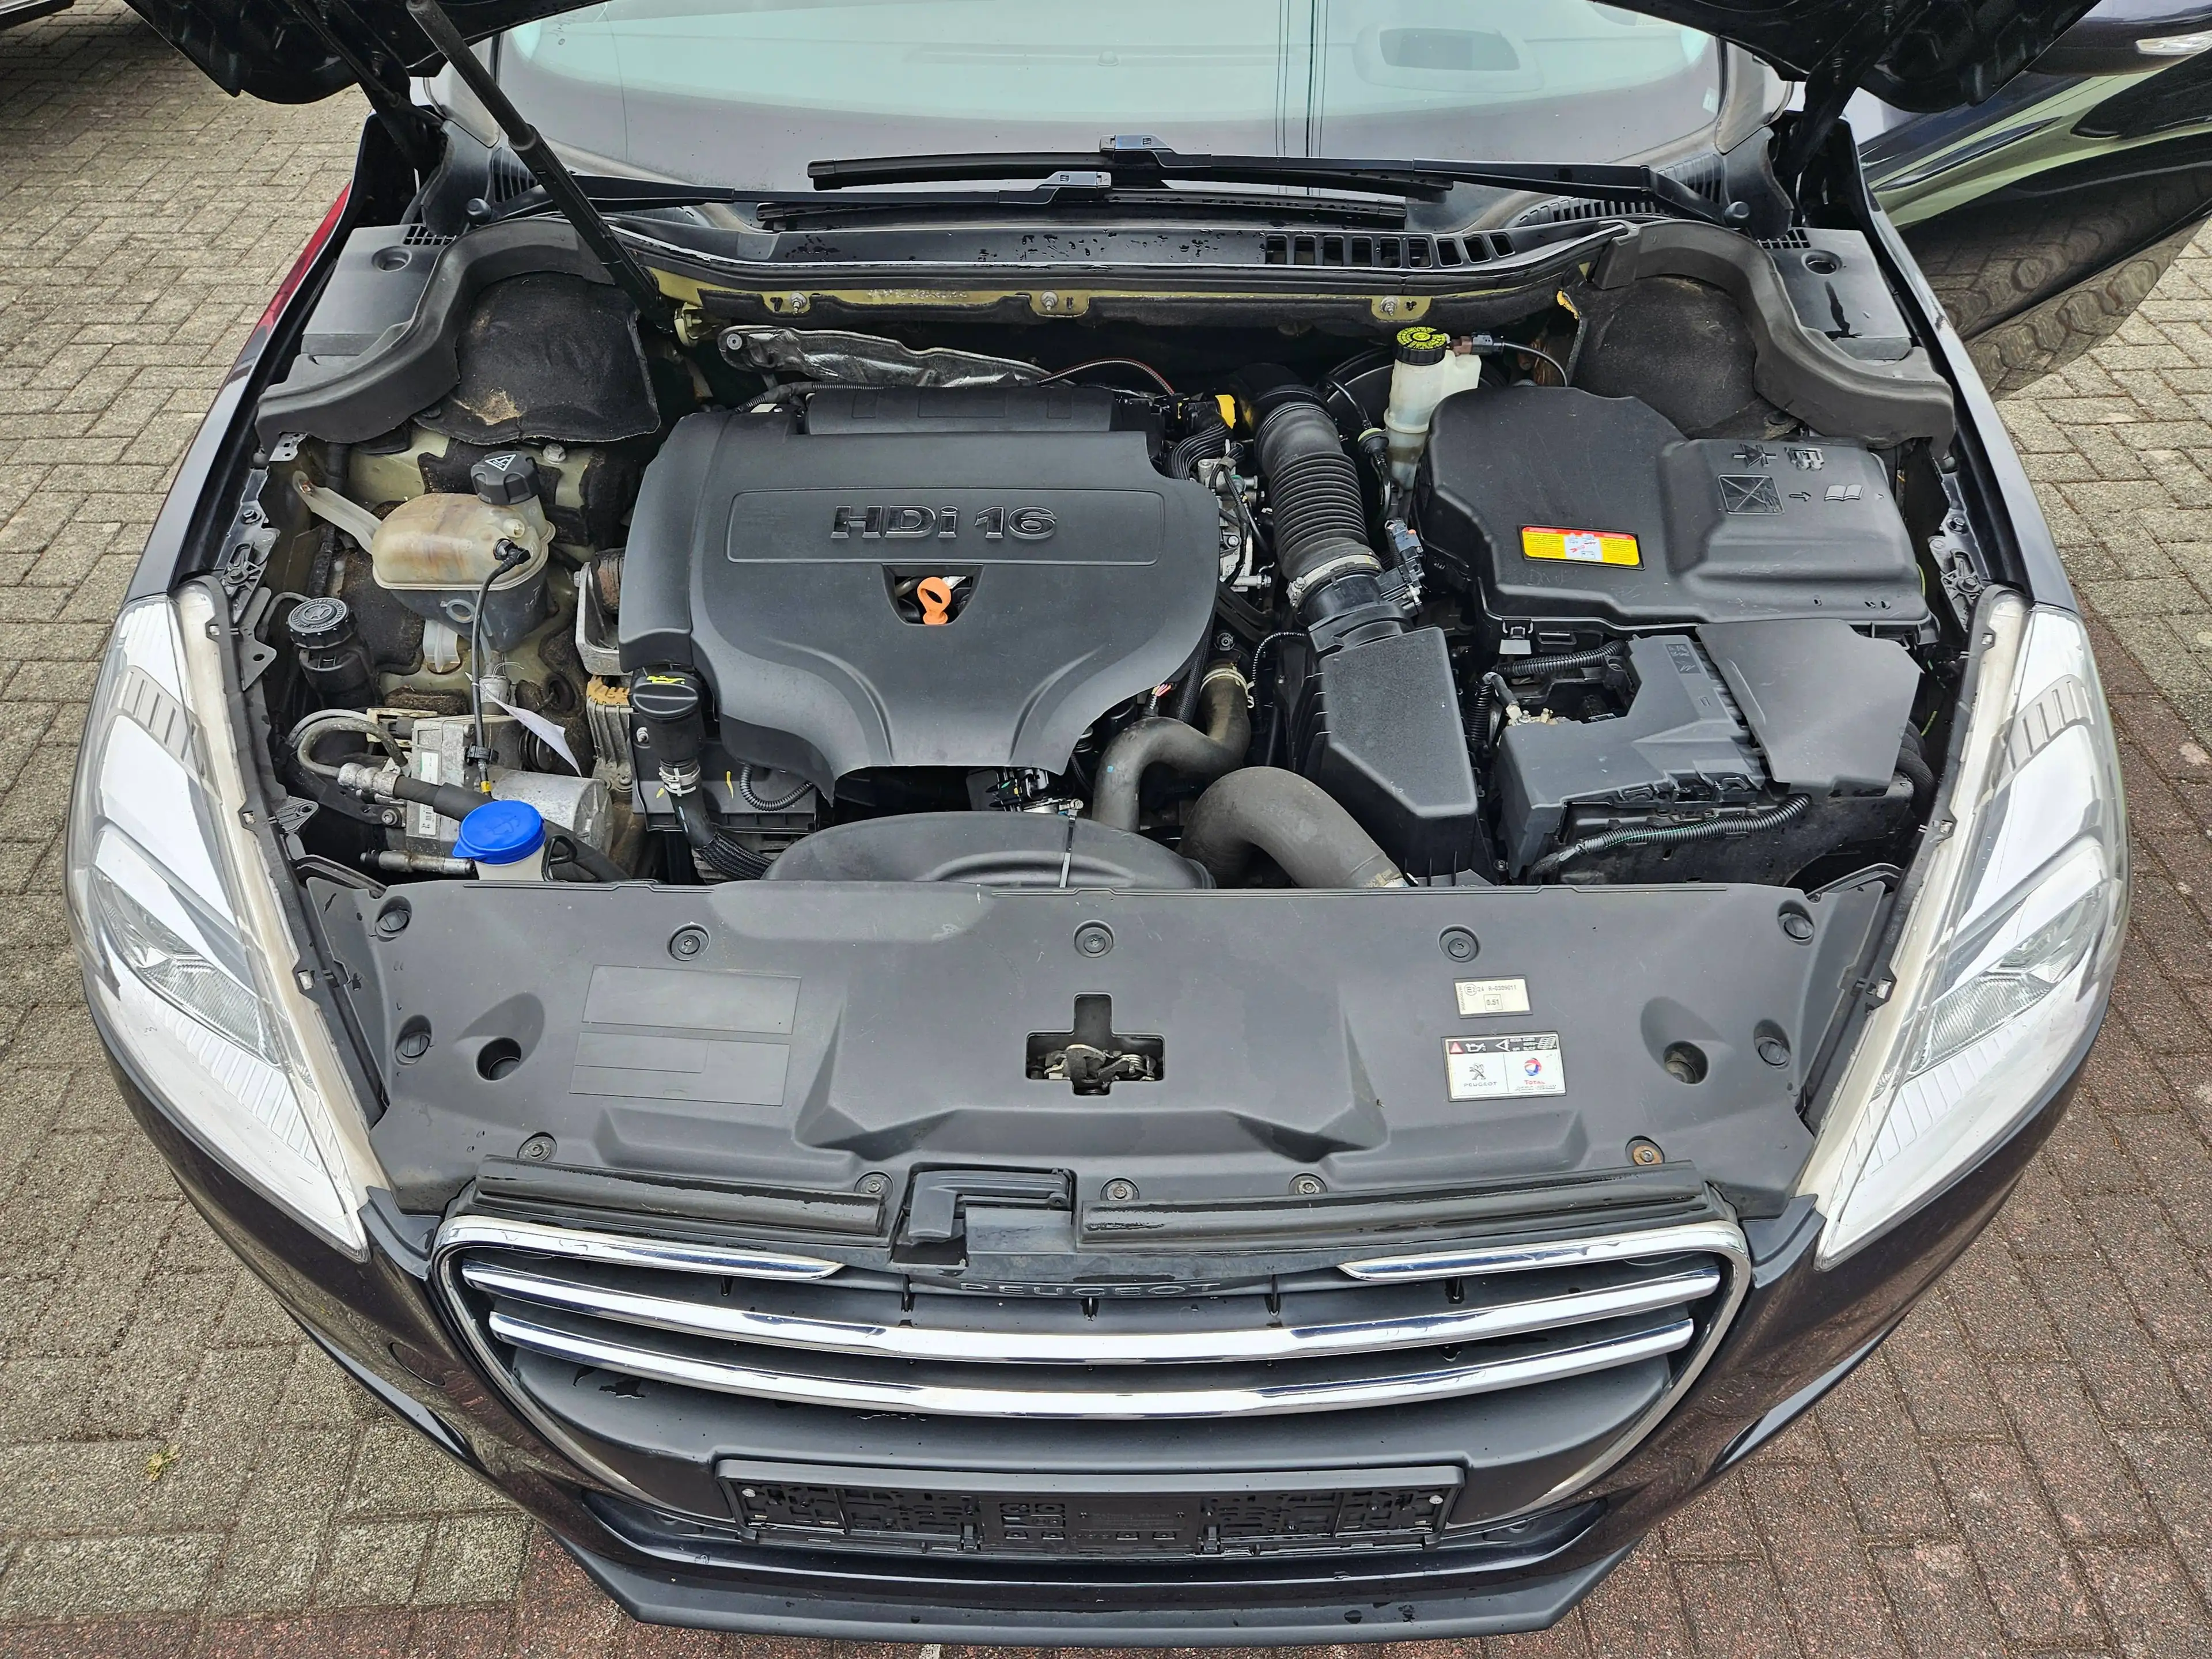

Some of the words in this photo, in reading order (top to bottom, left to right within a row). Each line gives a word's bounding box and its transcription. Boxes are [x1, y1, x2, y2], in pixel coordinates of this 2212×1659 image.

[831, 505, 959, 539] HDi
[975, 506, 1058, 540] 16
[960, 1282, 1221, 1296] PEUGEOT
